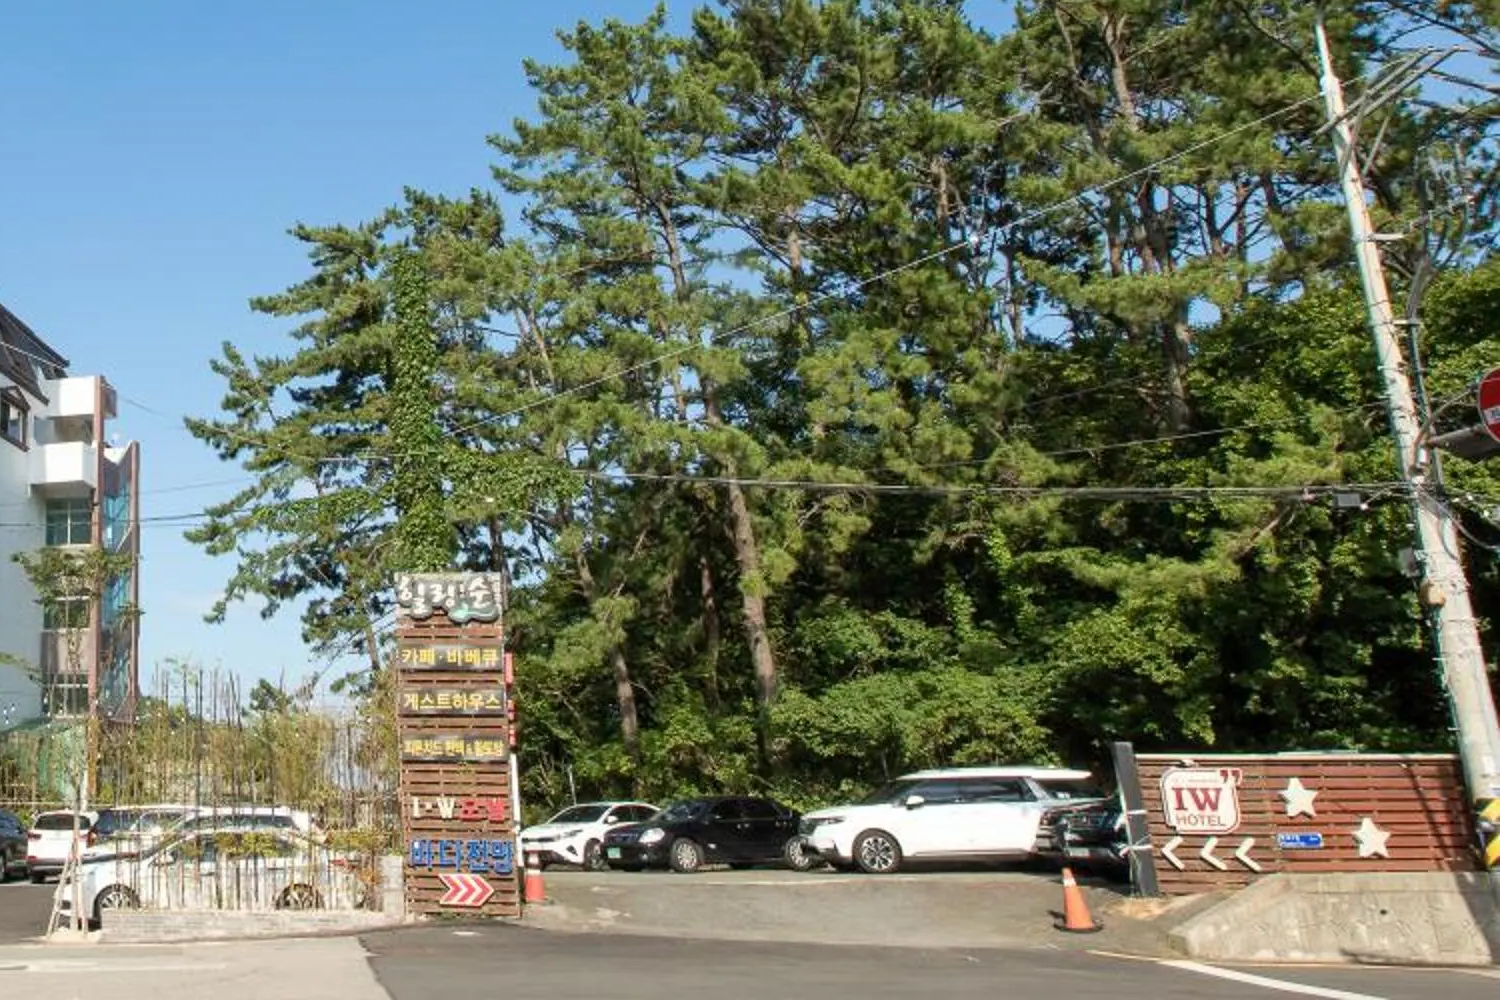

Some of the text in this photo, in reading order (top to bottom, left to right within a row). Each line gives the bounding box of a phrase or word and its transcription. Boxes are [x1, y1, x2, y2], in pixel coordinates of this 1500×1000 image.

[403, 692, 502, 711] 게스트하우스
[1172, 787, 1222, 812] IW
[1175, 814, 1227, 827] HOTEL
[412, 839, 513, 872] 바다전망
